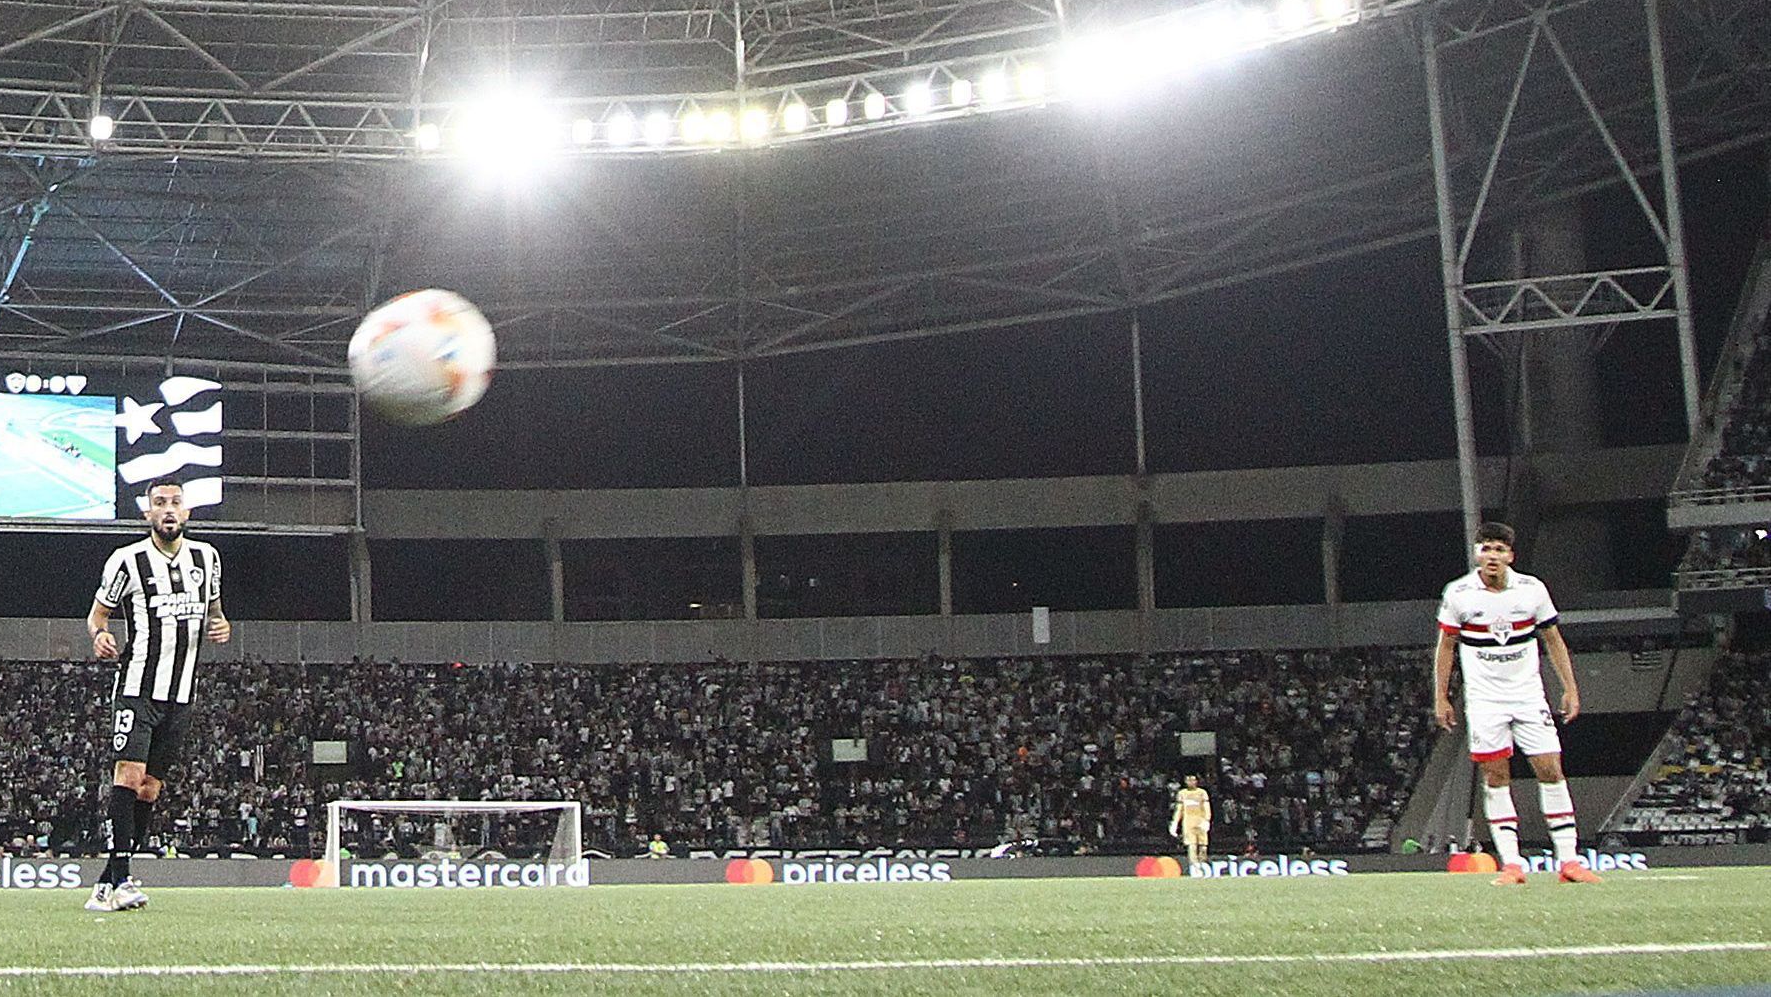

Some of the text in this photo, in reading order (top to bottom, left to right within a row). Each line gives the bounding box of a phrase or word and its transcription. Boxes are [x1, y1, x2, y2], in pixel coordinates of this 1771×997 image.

[114, 709, 135, 733] 13
[350, 858, 590, 888] mastercard
[782, 857, 952, 884] priceless
[1522, 848, 1648, 873] rieless
